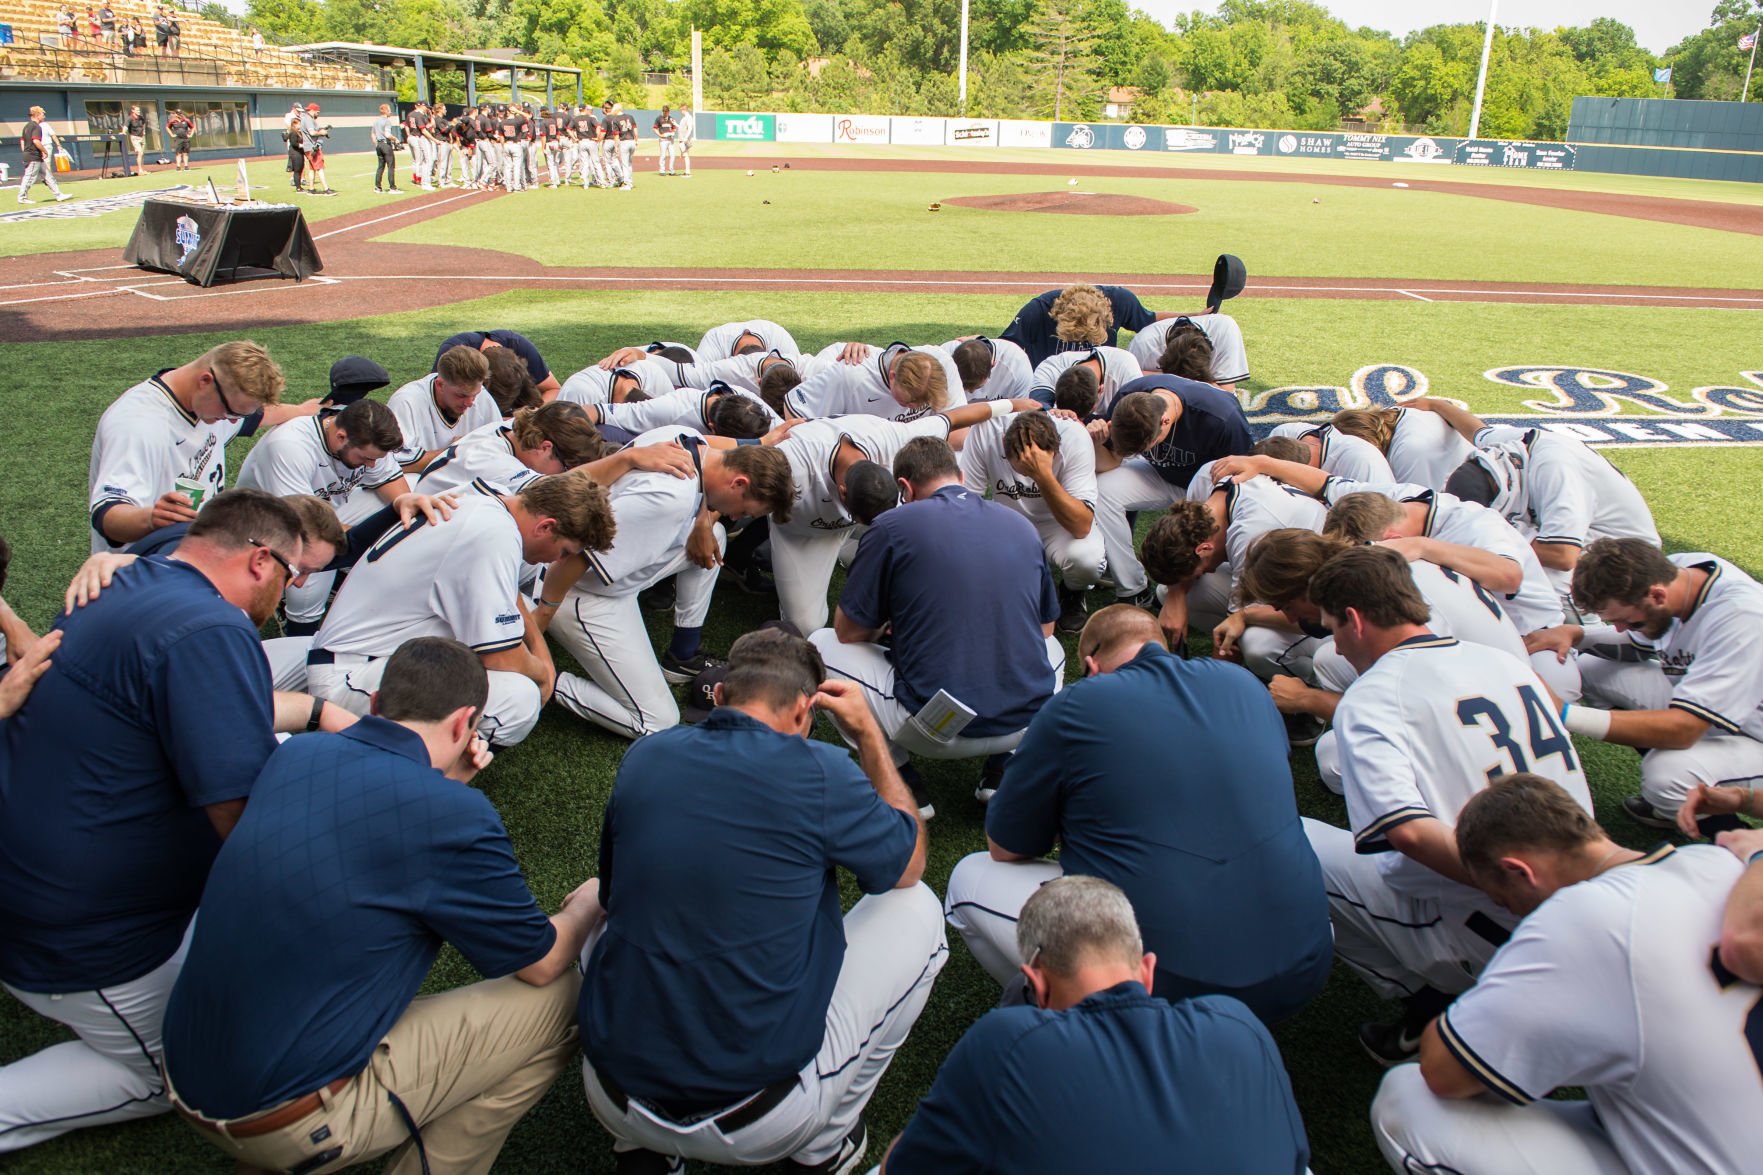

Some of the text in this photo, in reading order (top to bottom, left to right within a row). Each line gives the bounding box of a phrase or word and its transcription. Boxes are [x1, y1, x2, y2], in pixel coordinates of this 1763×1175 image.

[838, 119, 886, 141] Robinson
[1300, 137, 1332, 146] SHAW
[1343, 134, 1371, 142] TOMMY
[495, 614, 520, 624] SUMMIT
[1456, 684, 1577, 780] 34
